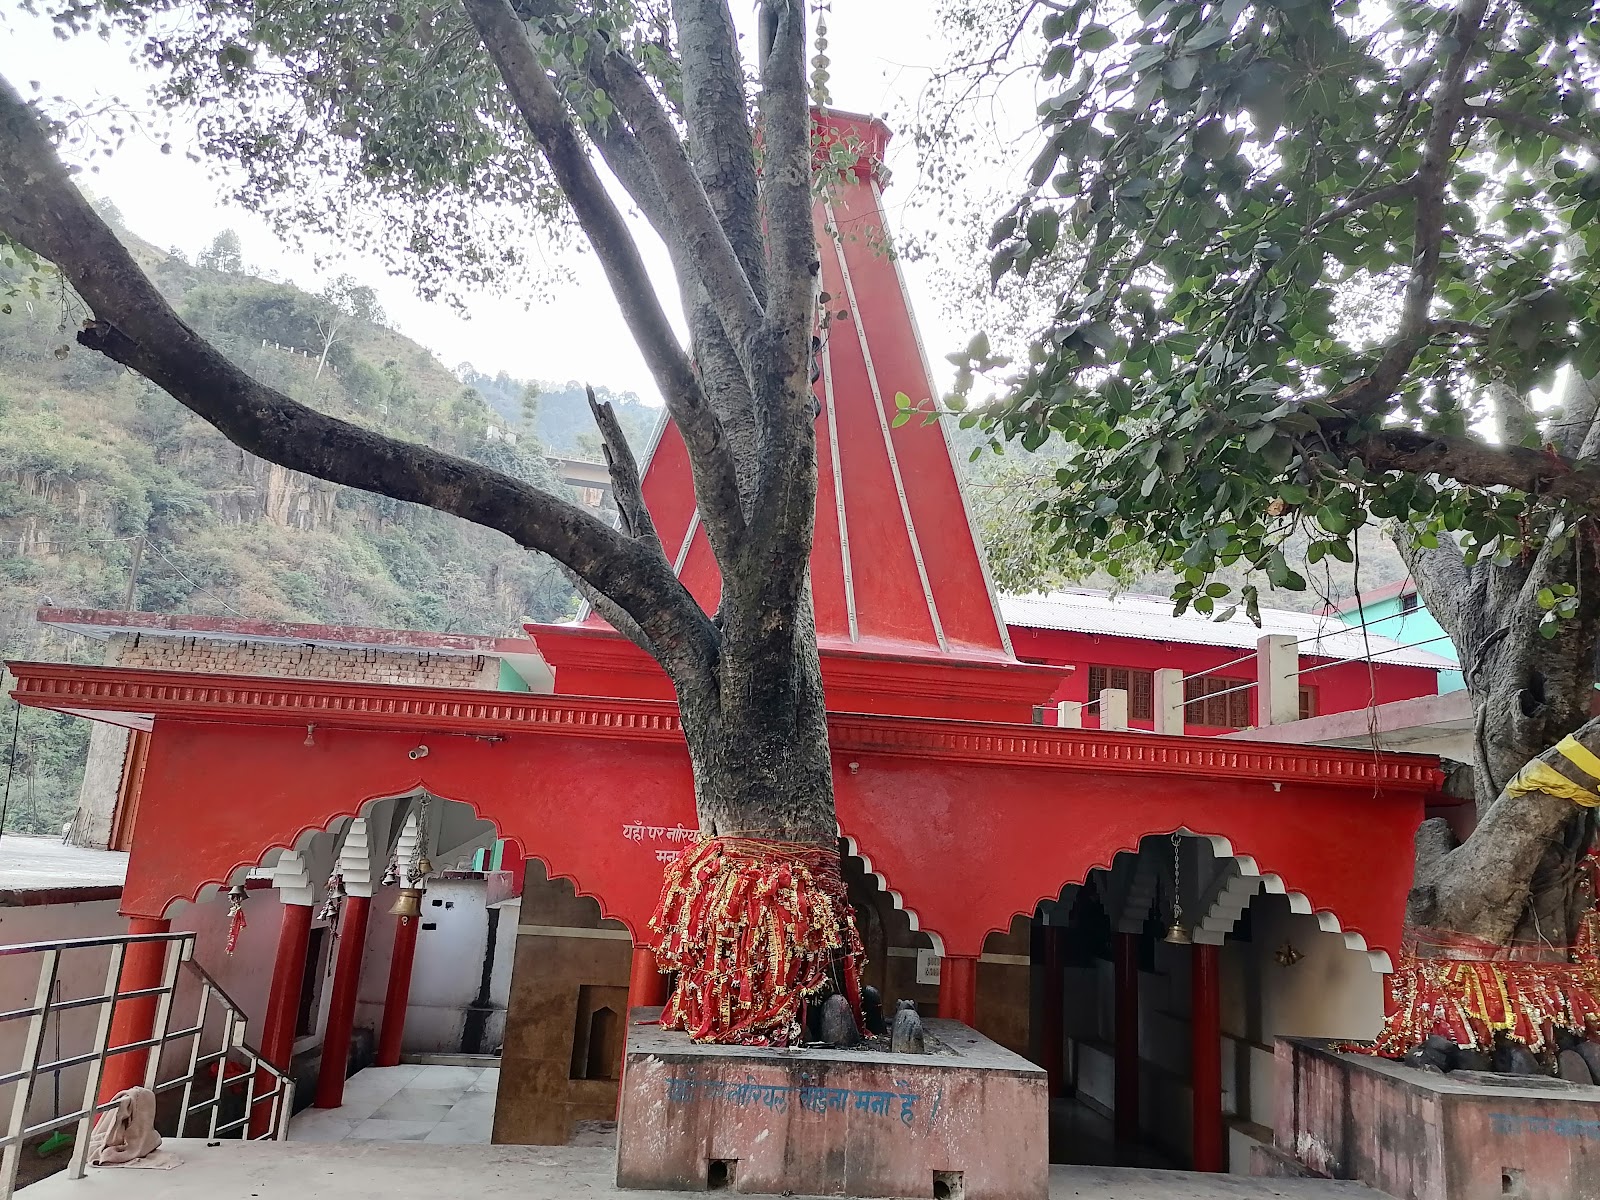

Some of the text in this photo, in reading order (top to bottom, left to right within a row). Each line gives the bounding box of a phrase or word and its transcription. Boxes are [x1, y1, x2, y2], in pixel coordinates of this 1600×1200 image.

[623, 820, 700, 846] यहाँ पर नारिय
[852, 1090, 897, 1117] मना
